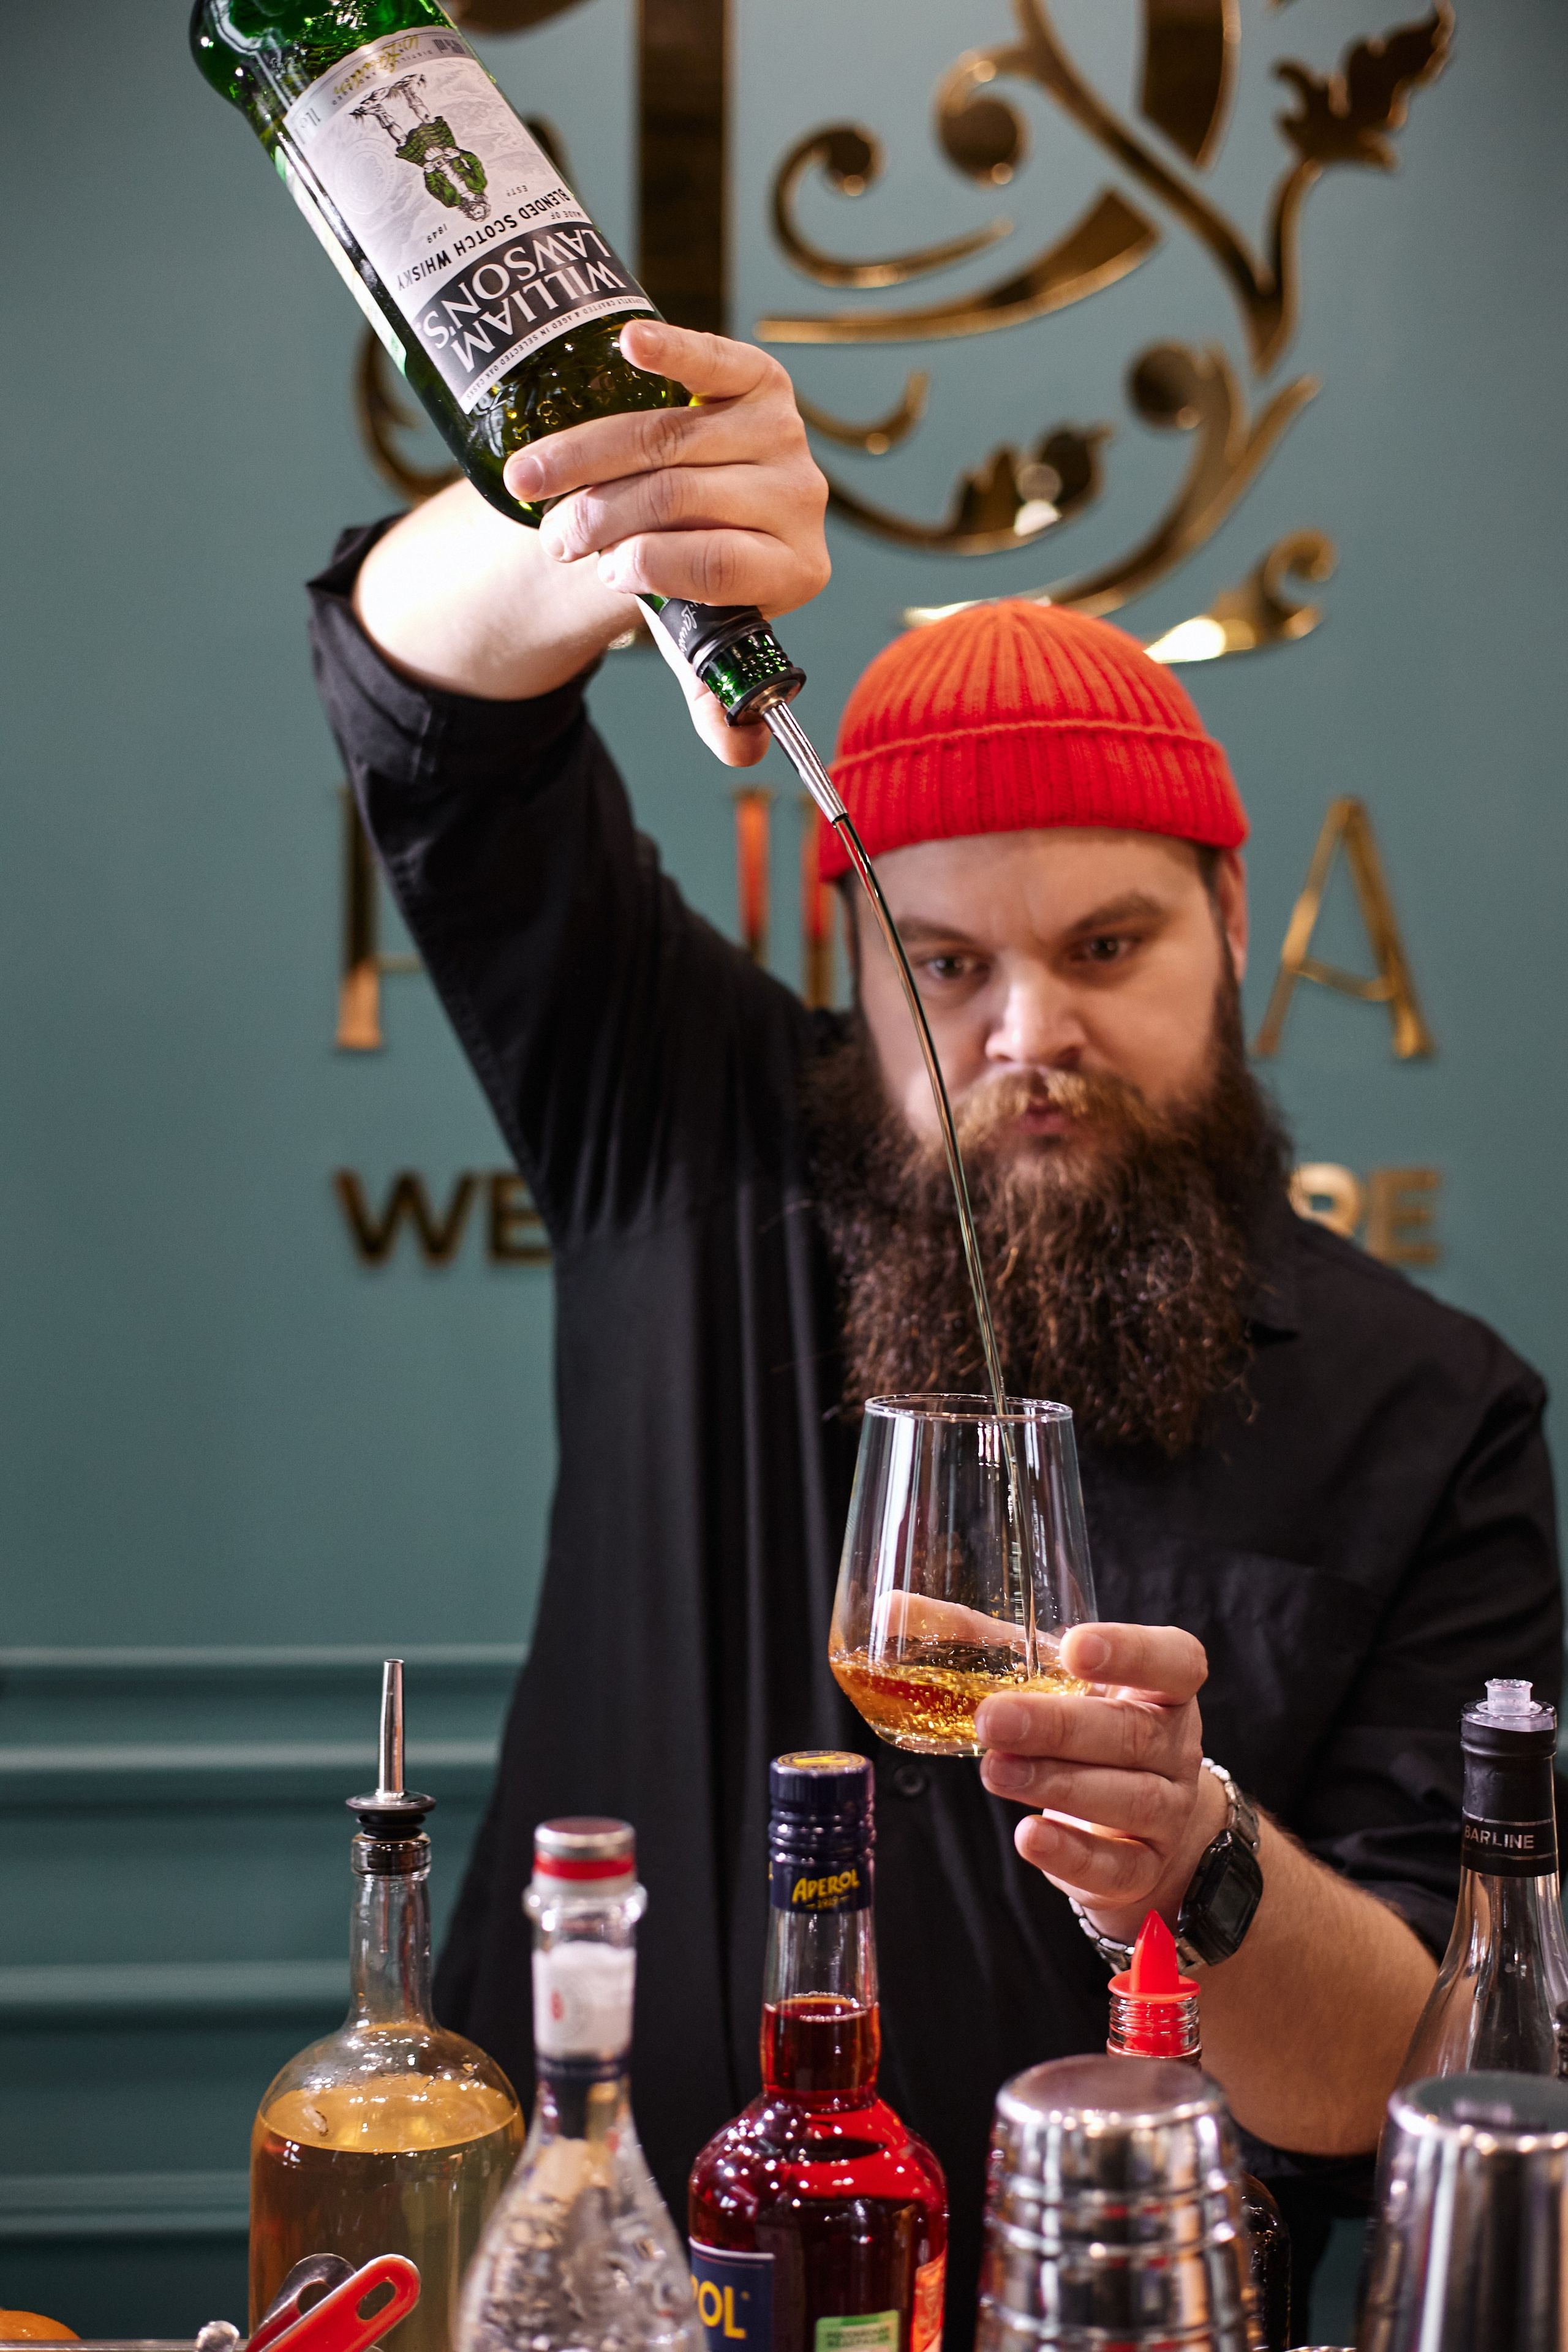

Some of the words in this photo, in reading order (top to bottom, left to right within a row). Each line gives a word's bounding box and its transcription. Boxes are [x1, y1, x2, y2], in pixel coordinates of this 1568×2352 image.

[517, 187, 570, 220] BLENDED
[549, 211, 562, 219] OF
[425, 223, 448, 244] 1849
[453, 213, 517, 256] SCOTCH
[395, 250, 452, 291] WHISKY
[423, 226, 611, 349] LAWSON'S
[450, 262, 627, 373] WILLIAM
[582, 299, 615, 314] CRAFTED
[538, 326, 550, 336] IN
[551, 314, 572, 330] AGED
[499, 333, 538, 366] SELECTED
[484, 364, 499, 379] OAK
[464, 377, 484, 400] CASKS
[1464, 1825, 1534, 1849] BARLINE
[791, 1869, 861, 1904] APEROL
